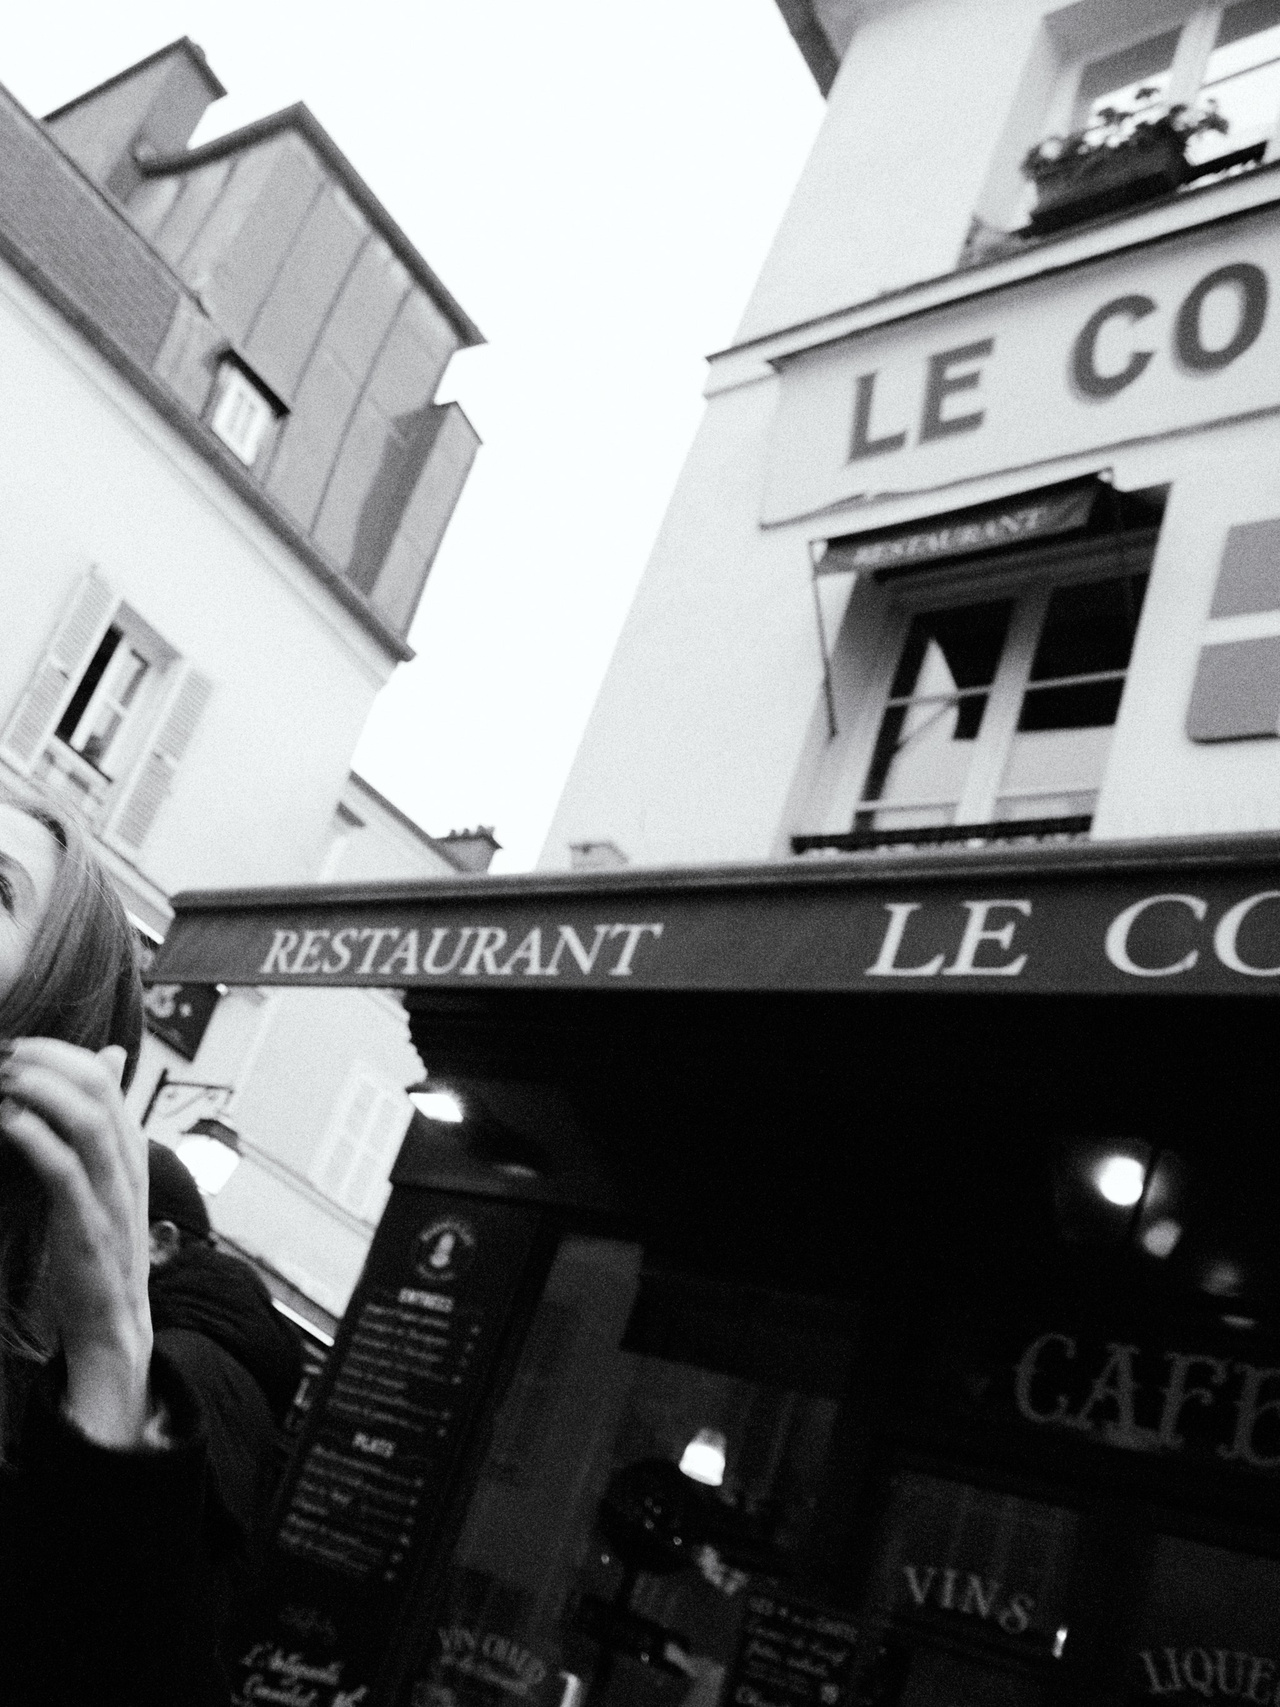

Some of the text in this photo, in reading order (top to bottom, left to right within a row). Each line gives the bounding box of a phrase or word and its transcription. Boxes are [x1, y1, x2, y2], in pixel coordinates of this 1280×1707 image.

[846, 262, 1269, 463] LE CO
[852, 507, 1047, 565] RESTAURANT
[260, 923, 664, 977] RESTAURANT
[864, 890, 1280, 978] LE CO
[904, 1566, 1037, 1634] VINS
[1138, 1646, 1280, 1706] LIQUE
